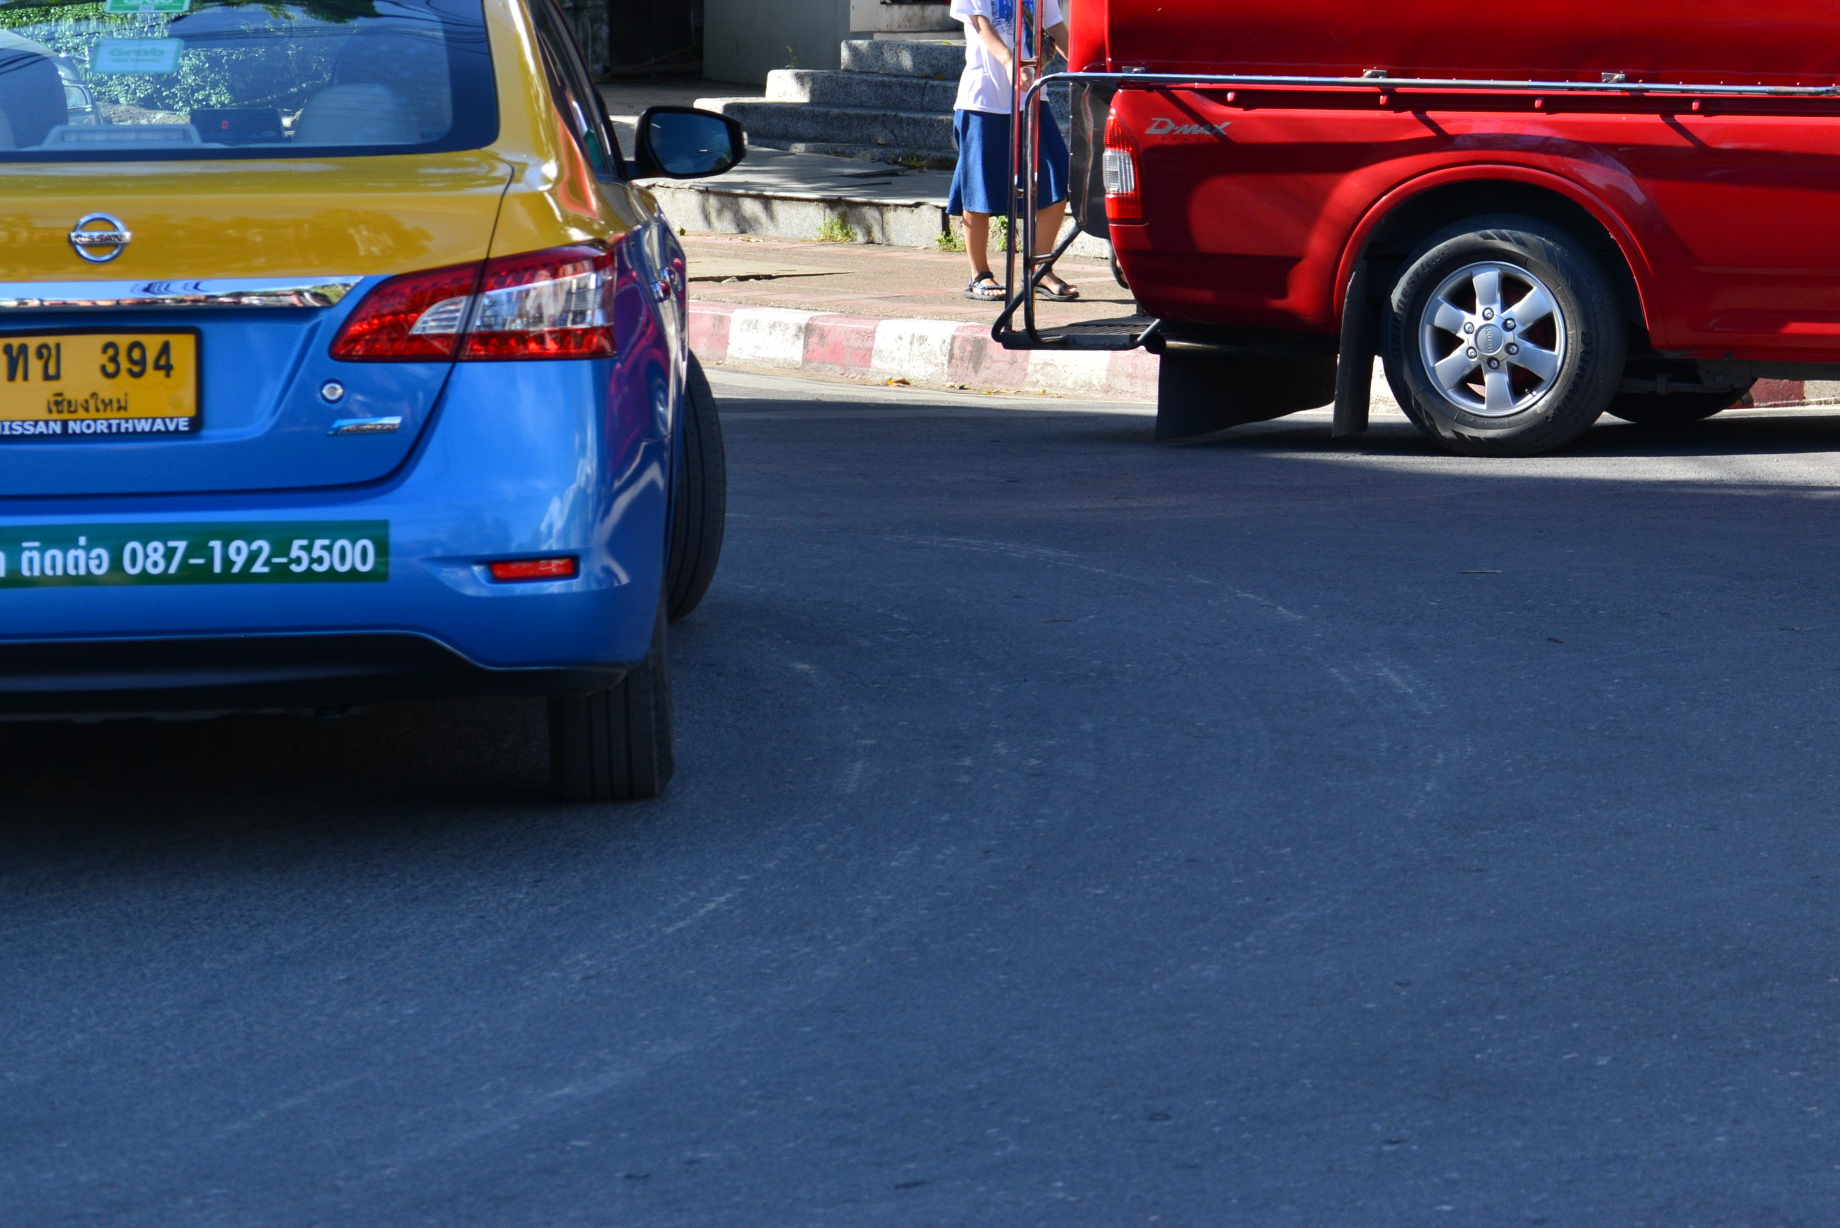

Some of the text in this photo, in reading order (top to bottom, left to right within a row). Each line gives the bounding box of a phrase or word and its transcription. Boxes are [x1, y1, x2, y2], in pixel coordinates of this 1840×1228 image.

[2, 340, 174, 382] ทข 394
[47, 392, 129, 415] เชียงใหม่
[0, 417, 189, 435] ISSAN NORTHWAVE
[21, 536, 110, 576] ติดต่อ
[122, 538, 375, 575] 087-192-5500
